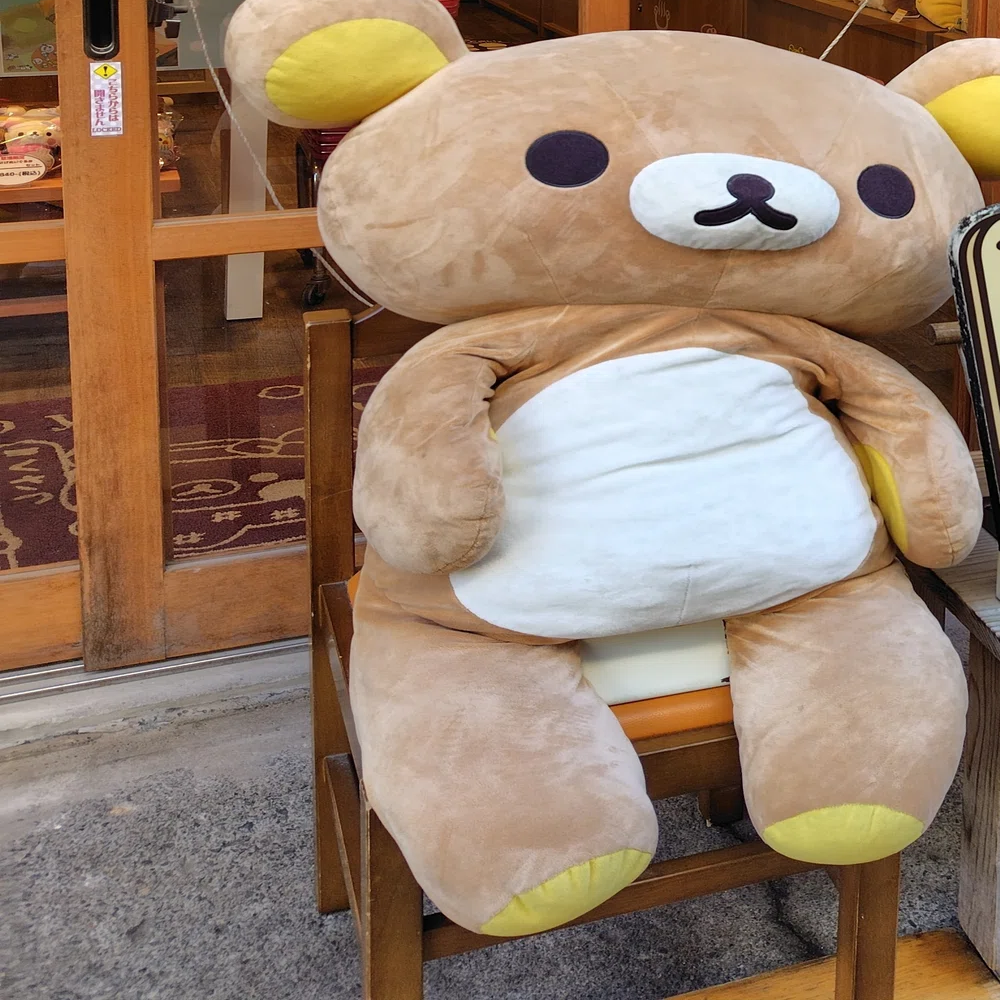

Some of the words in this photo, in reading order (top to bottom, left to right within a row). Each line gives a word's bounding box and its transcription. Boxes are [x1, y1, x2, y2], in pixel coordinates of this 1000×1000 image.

[108, 78, 120, 122] こちらからは
